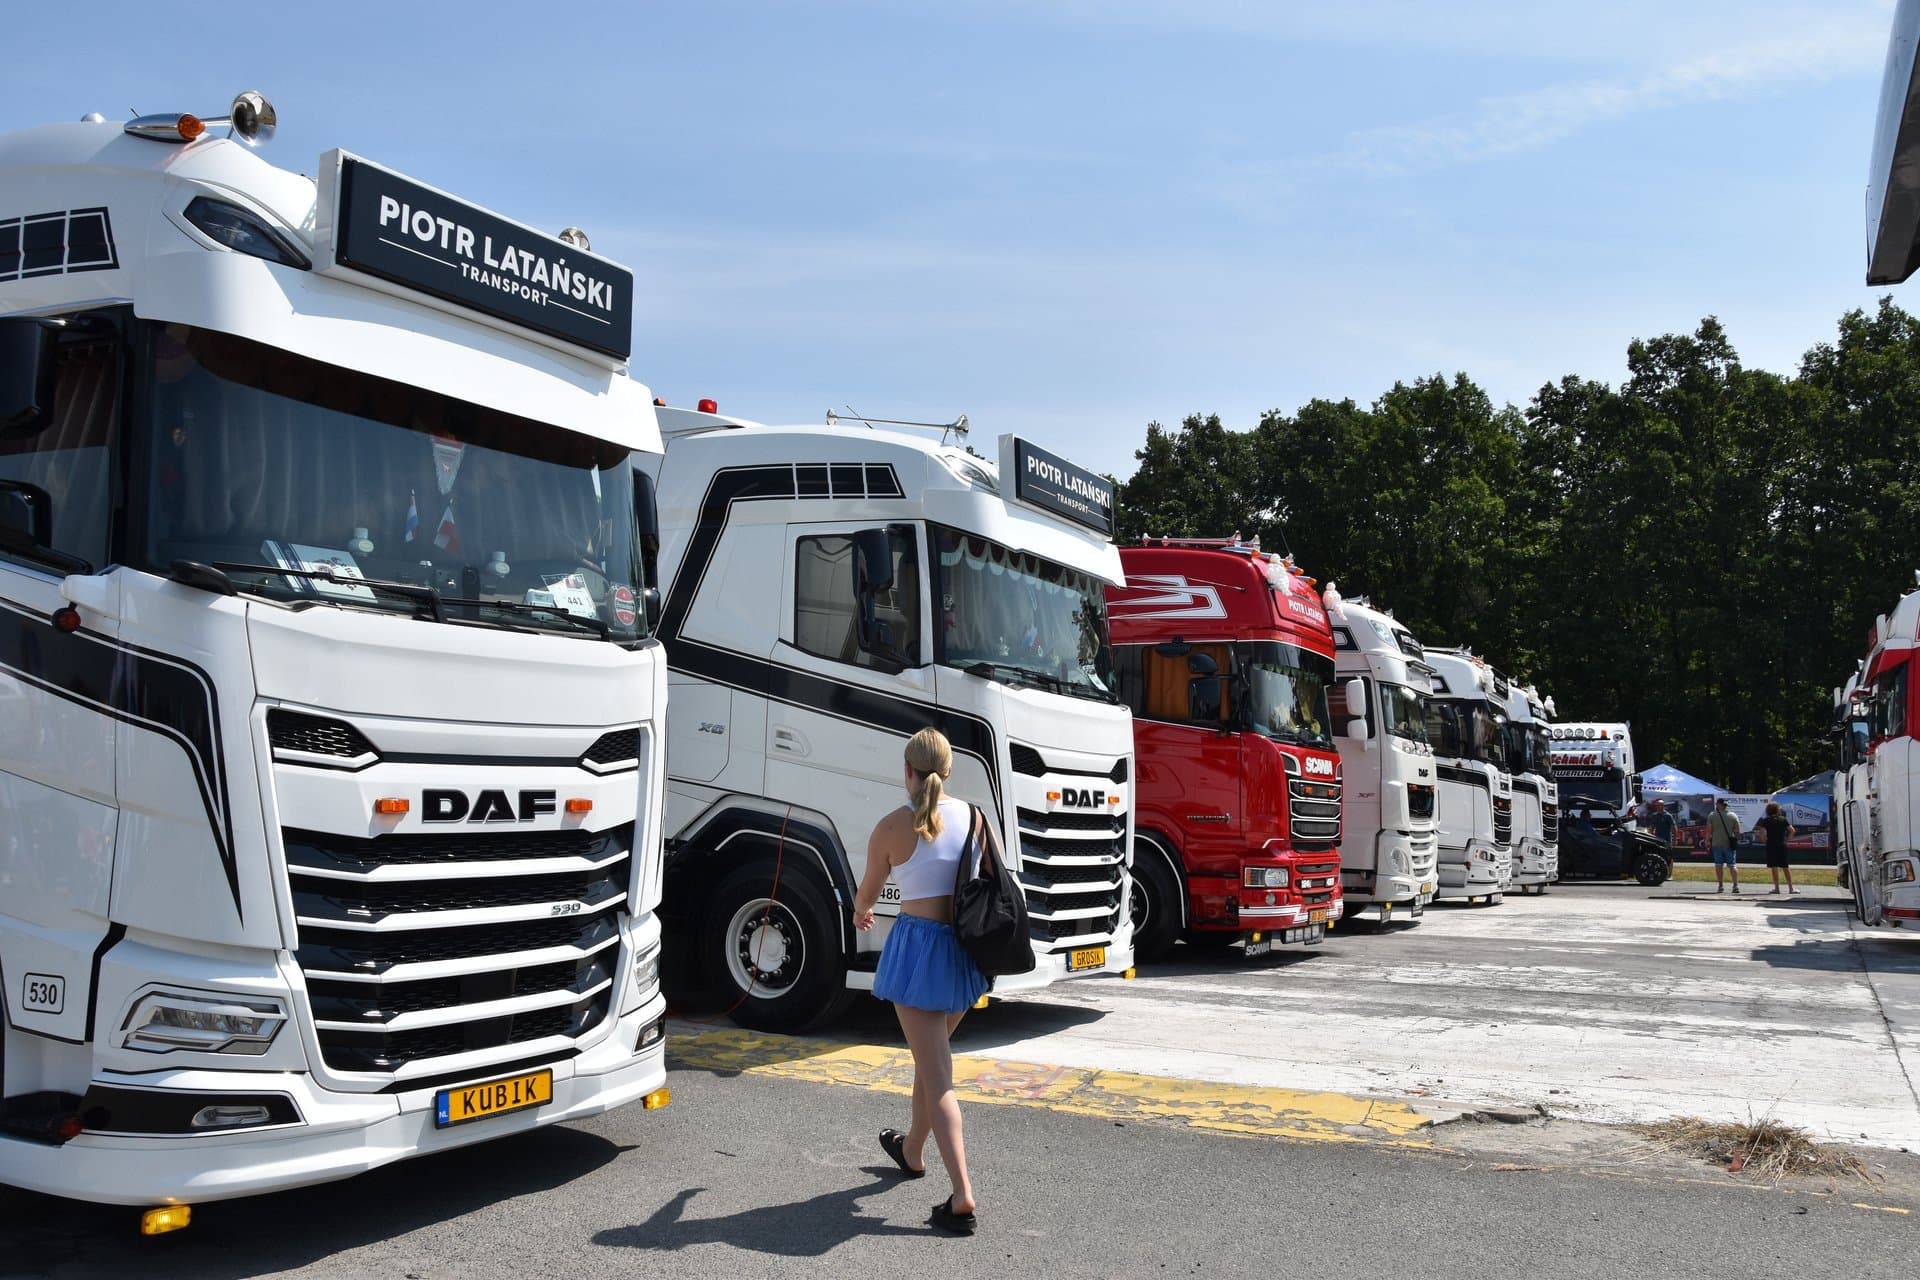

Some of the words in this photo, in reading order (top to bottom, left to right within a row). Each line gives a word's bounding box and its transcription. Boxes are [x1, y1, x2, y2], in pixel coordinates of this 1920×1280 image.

[379, 195, 475, 258] PIOTR
[483, 236, 613, 311] LATAŃSKI
[460, 263, 549, 306] TRANSPORT
[1027, 455, 1063, 486] PIOTR
[1064, 472, 1110, 509] LATAŃSKI
[1056, 493, 1089, 514] TRANSPORT
[1305, 756, 1333, 776] SCANIA
[422, 789, 557, 824] DAF
[1062, 788, 1105, 808] DAF
[551, 903, 581, 915] 530
[1076, 951, 1101, 966] GROSIK
[29, 982, 58, 1005] 530
[463, 1077, 537, 1115] KUBIK
